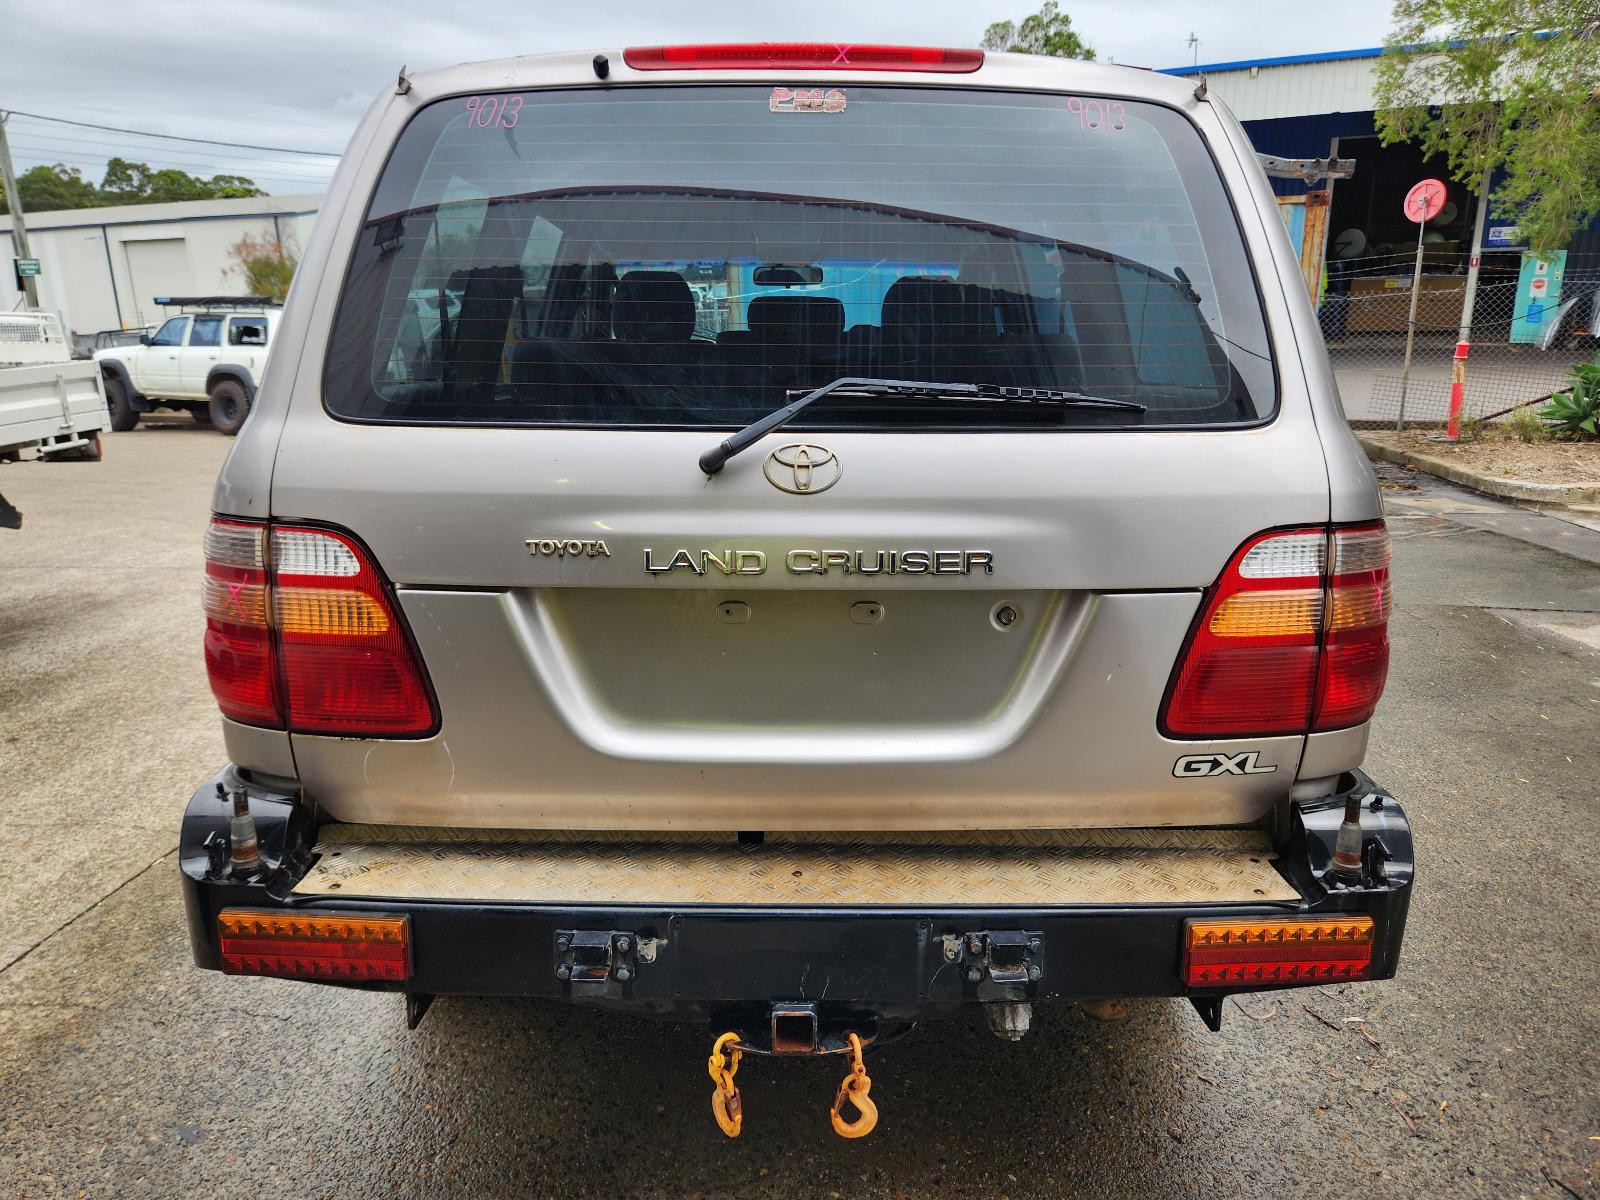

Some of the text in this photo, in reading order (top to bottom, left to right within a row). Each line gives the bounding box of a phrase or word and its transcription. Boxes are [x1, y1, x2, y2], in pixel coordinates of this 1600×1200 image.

[466, 95, 523, 129] 9013
[1067, 96, 1126, 132] 9013
[525, 539, 611, 557] TOYOTA
[643, 548, 994, 574] LAND CRUISER
[1172, 751, 1278, 778] GXL
